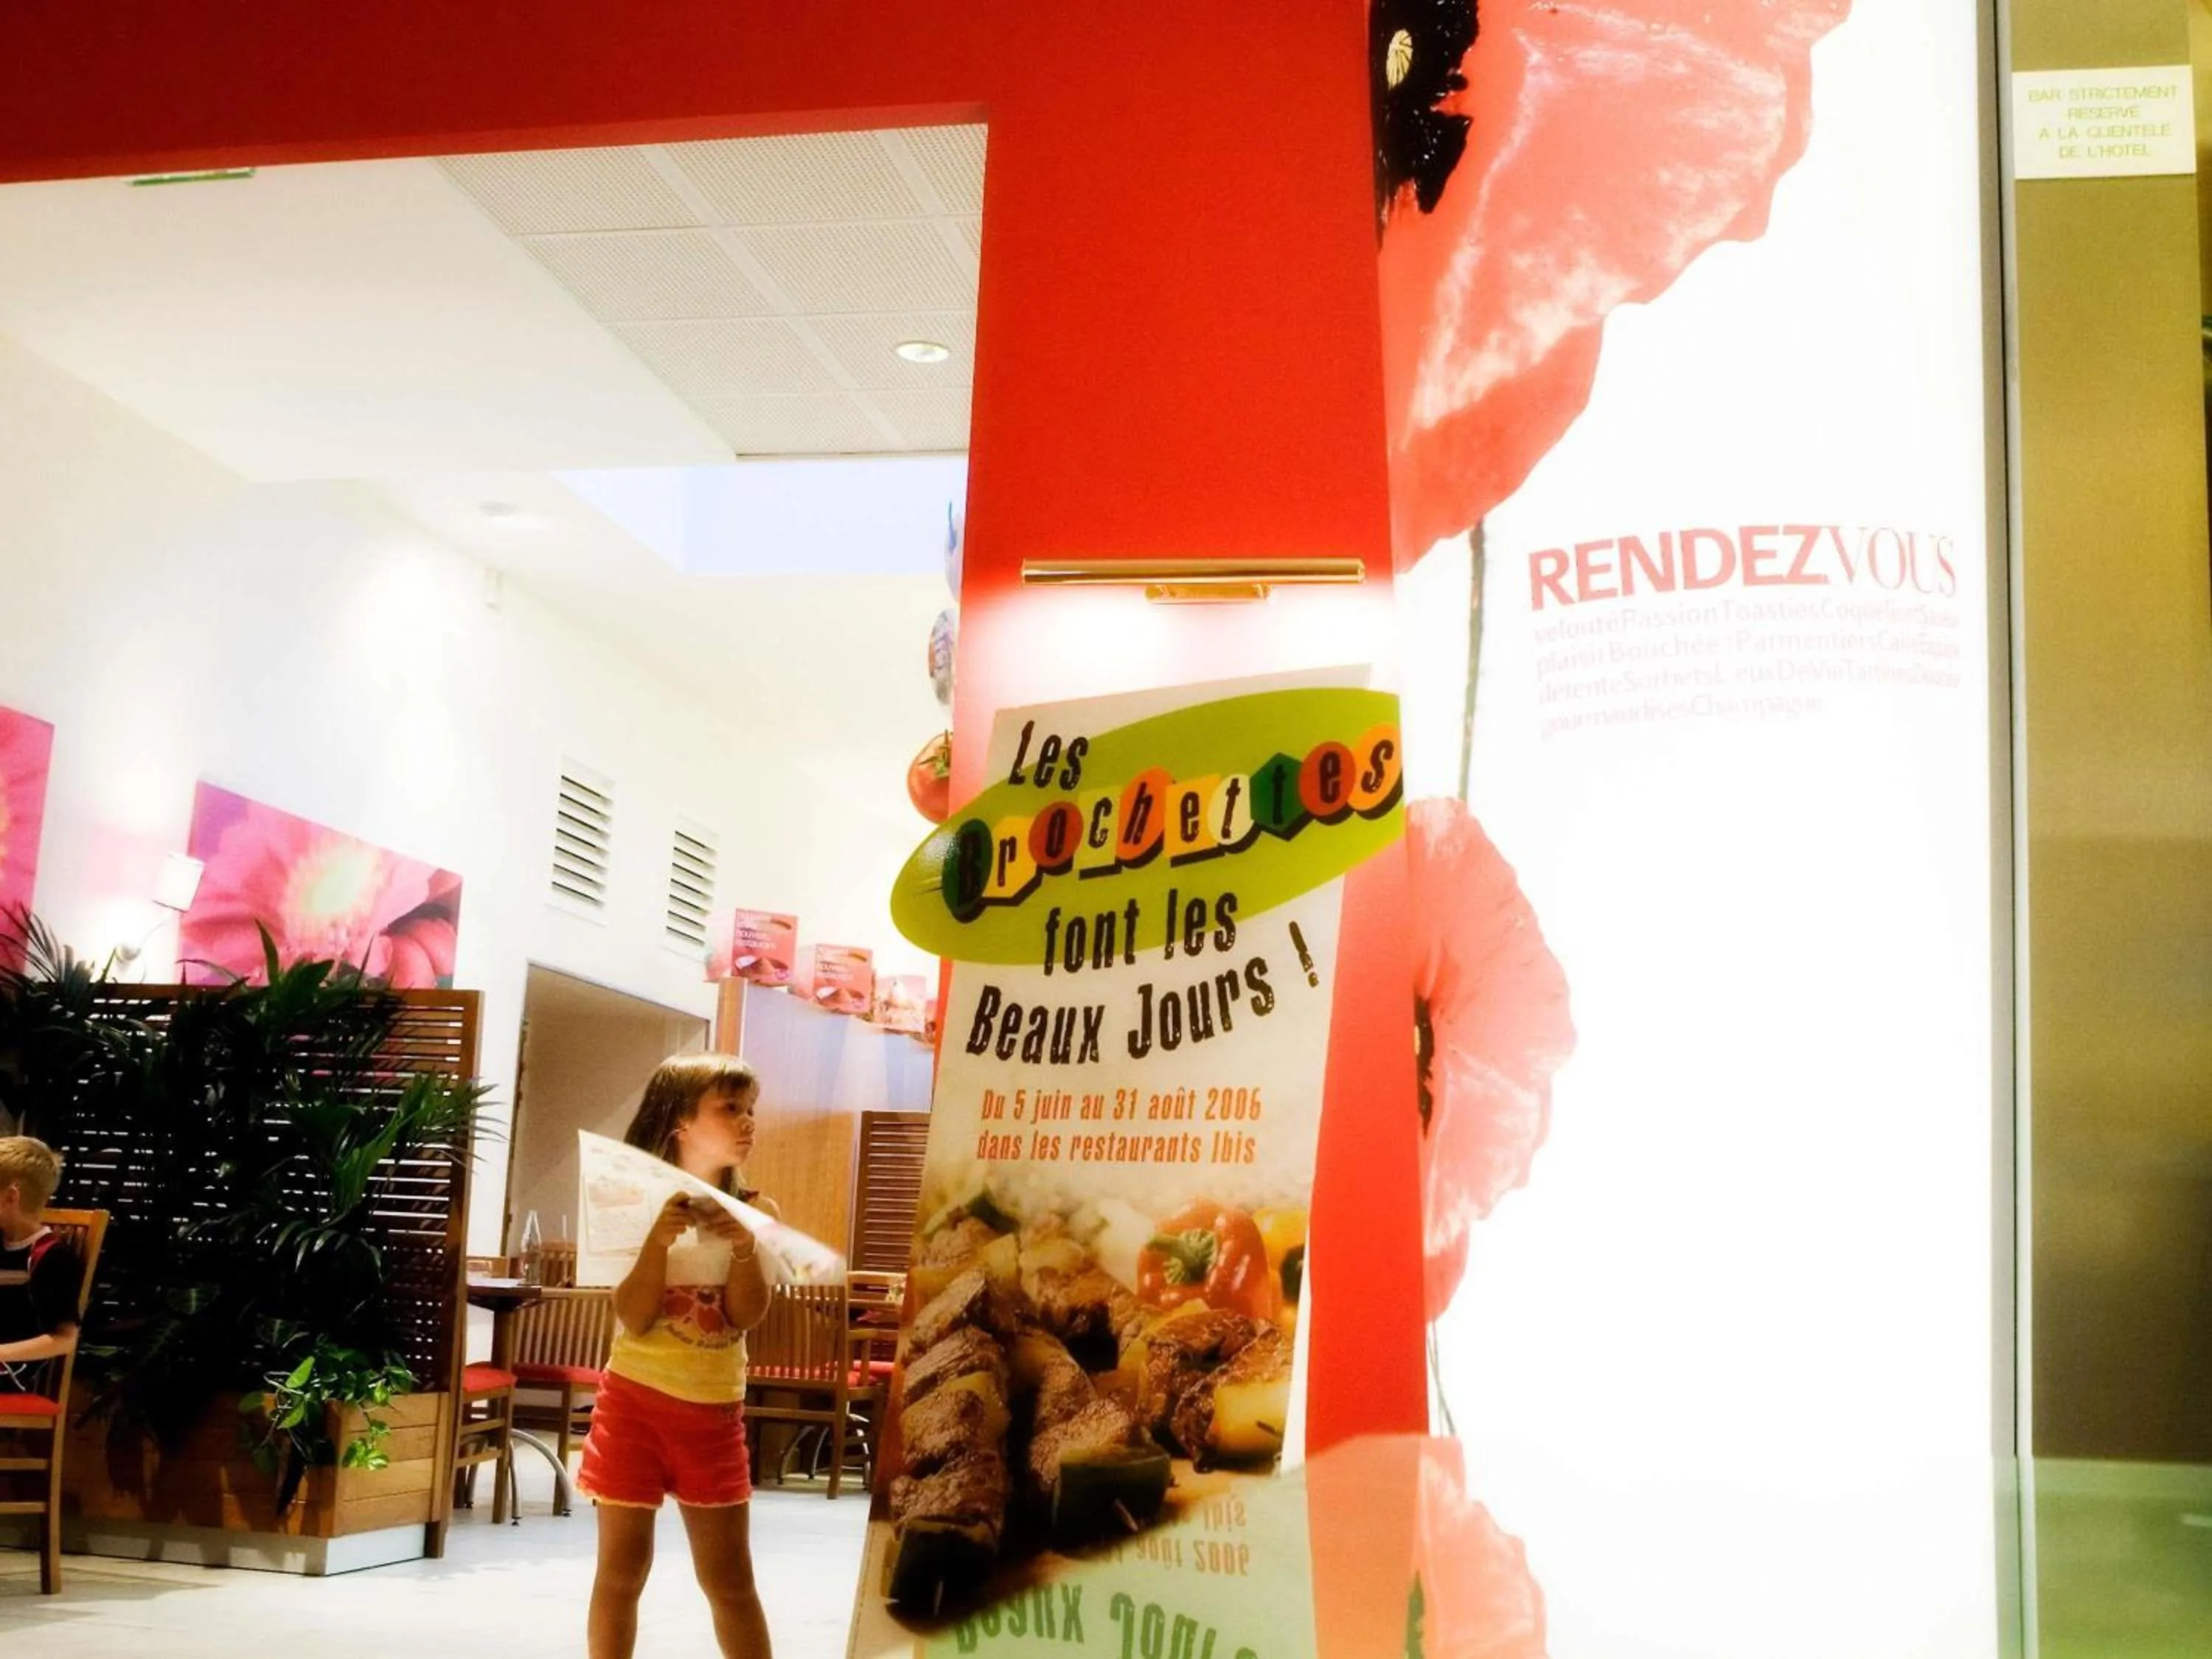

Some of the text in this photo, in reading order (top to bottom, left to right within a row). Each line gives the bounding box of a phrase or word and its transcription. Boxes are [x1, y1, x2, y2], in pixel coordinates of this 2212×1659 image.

[2028, 86, 2178, 102] BAR STRICTEMENT
[2058, 127, 2078, 140] LA
[2059, 145, 2080, 159] DE
[1008, 720, 1089, 791] Les
[1043, 888, 1239, 976] font les
[966, 984, 1106, 1064] Beaux
[1127, 956, 1276, 1060] Jours
[981, 1087, 1262, 1124] Du 5 juin au 31 août 2006
[976, 1130, 1256, 1164] dans les restaurants Ibis
